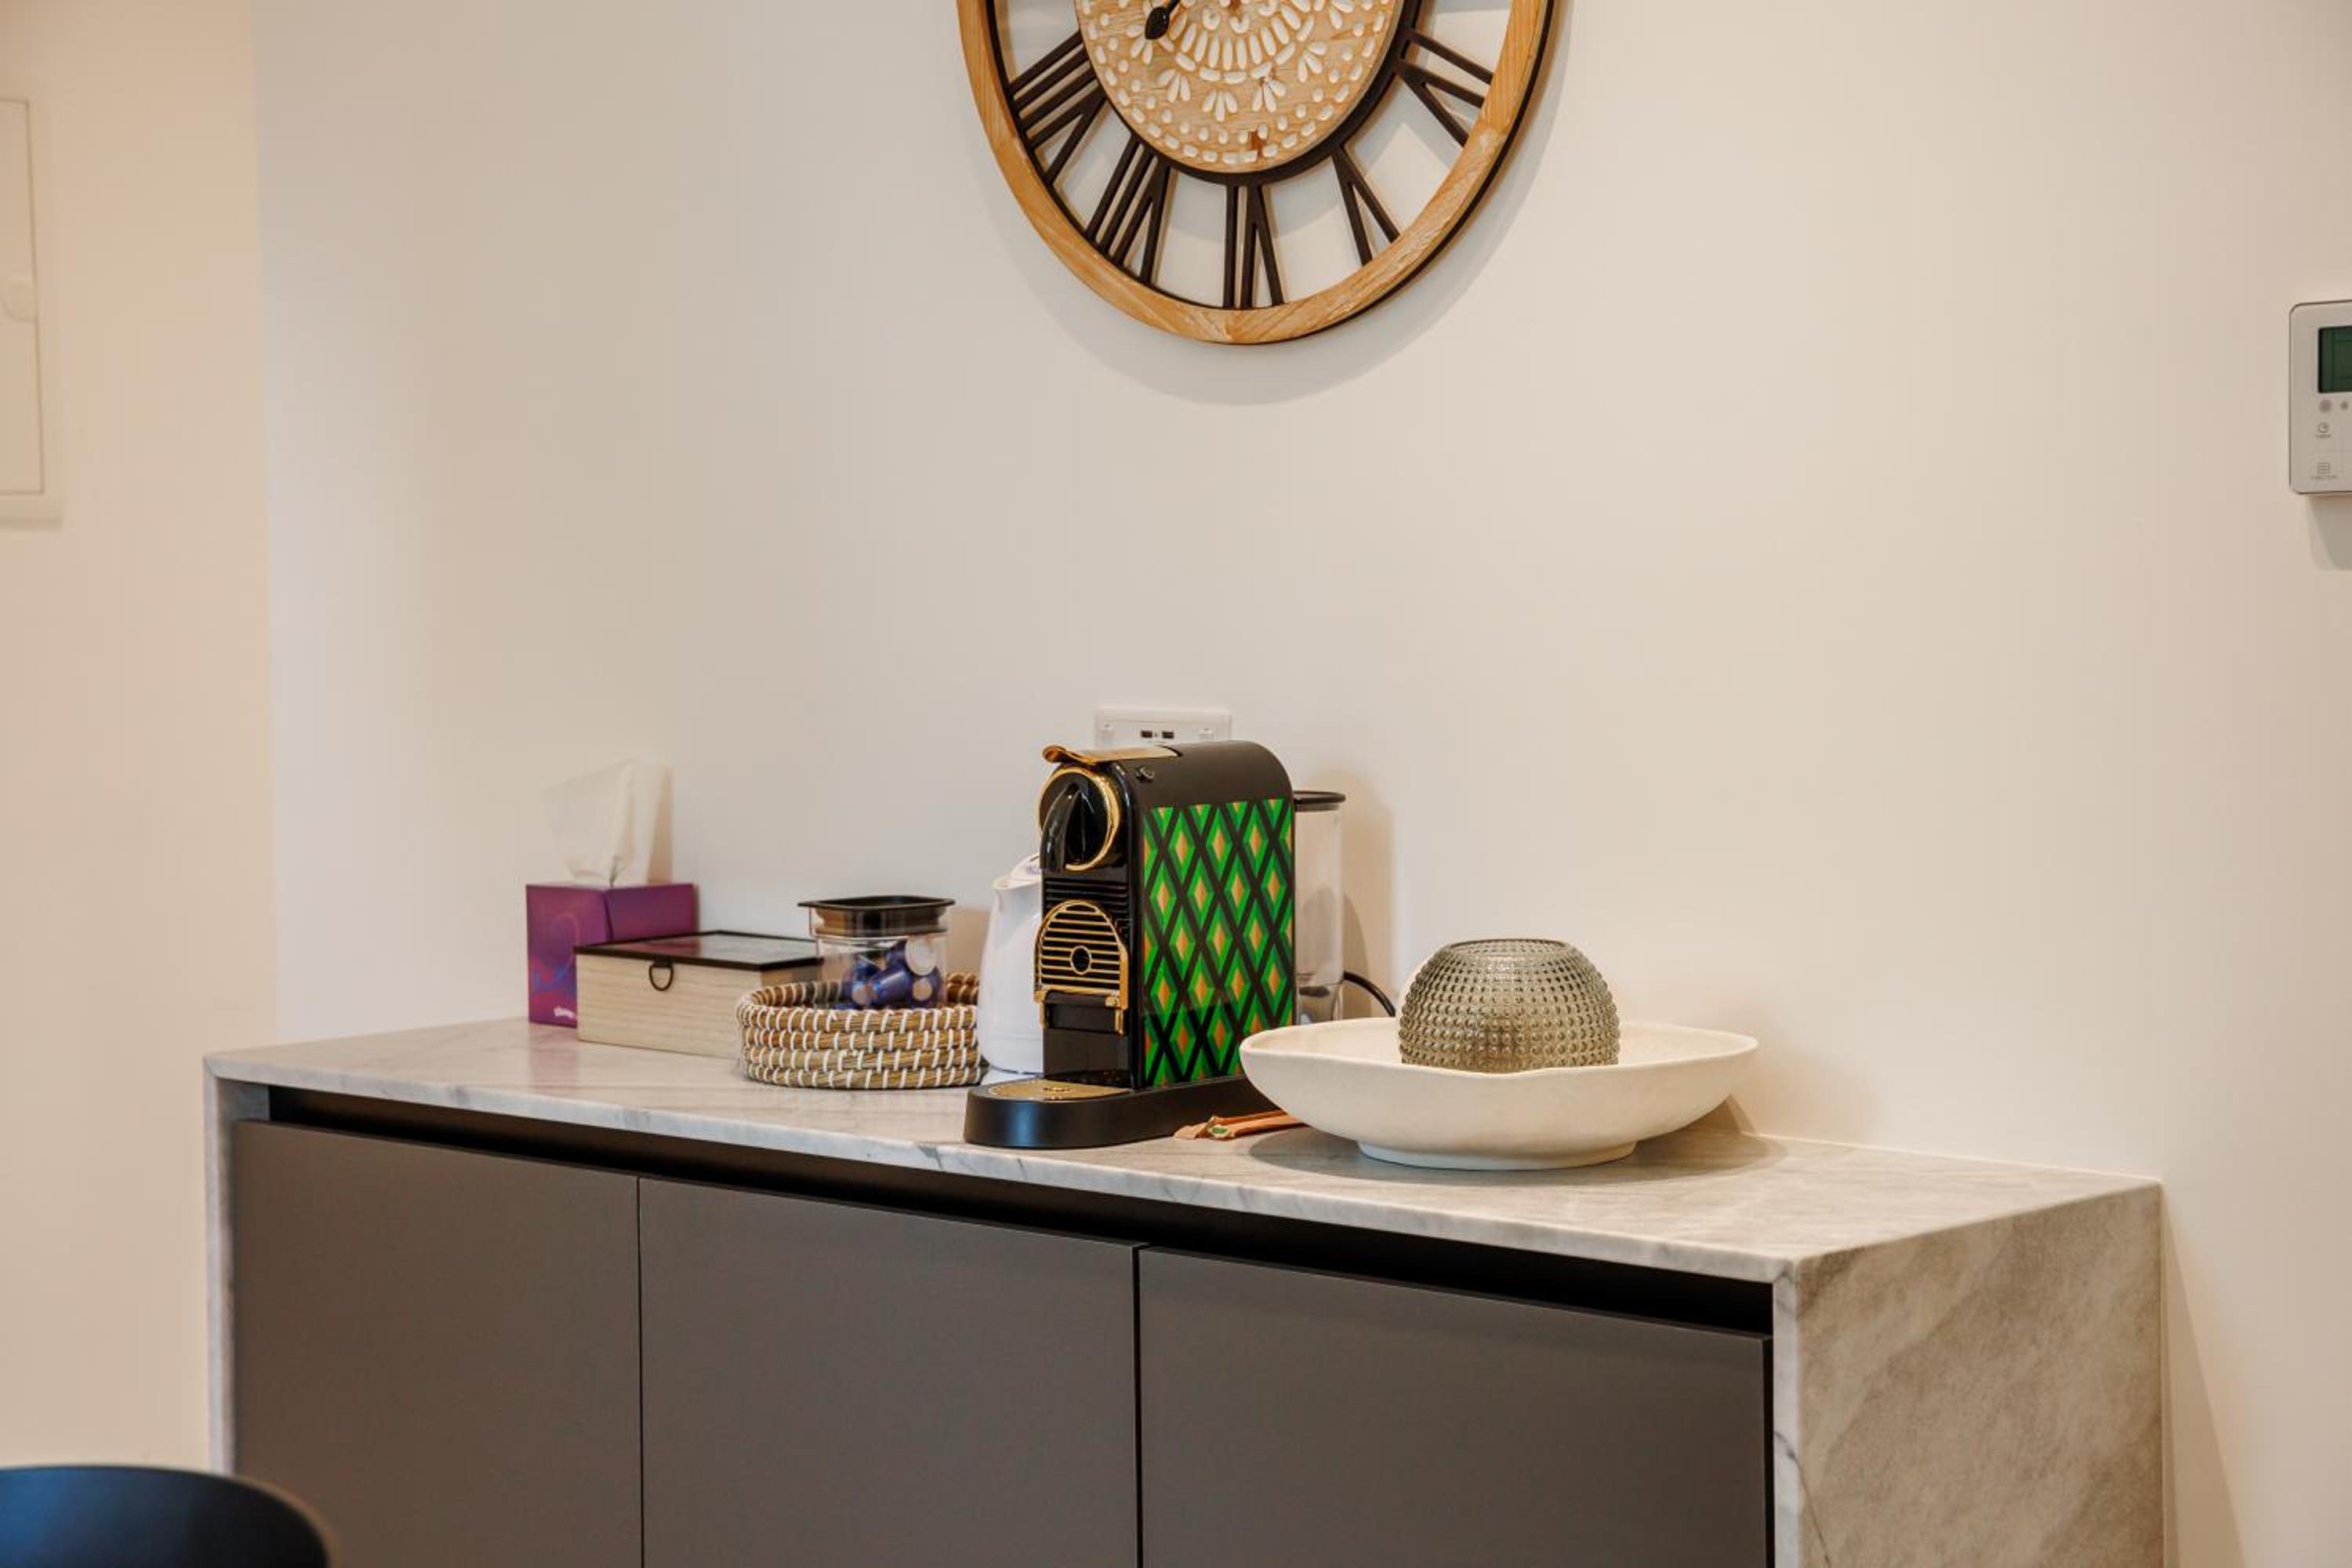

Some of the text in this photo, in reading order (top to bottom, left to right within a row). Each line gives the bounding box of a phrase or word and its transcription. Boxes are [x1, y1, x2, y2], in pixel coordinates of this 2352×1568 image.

[1008, 30, 1106, 187] VIII
[1394, 28, 1493, 147] IV
[1084, 135, 1171, 284] VII
[1223, 183, 1284, 309] VI
[1331, 143, 1400, 266] V
